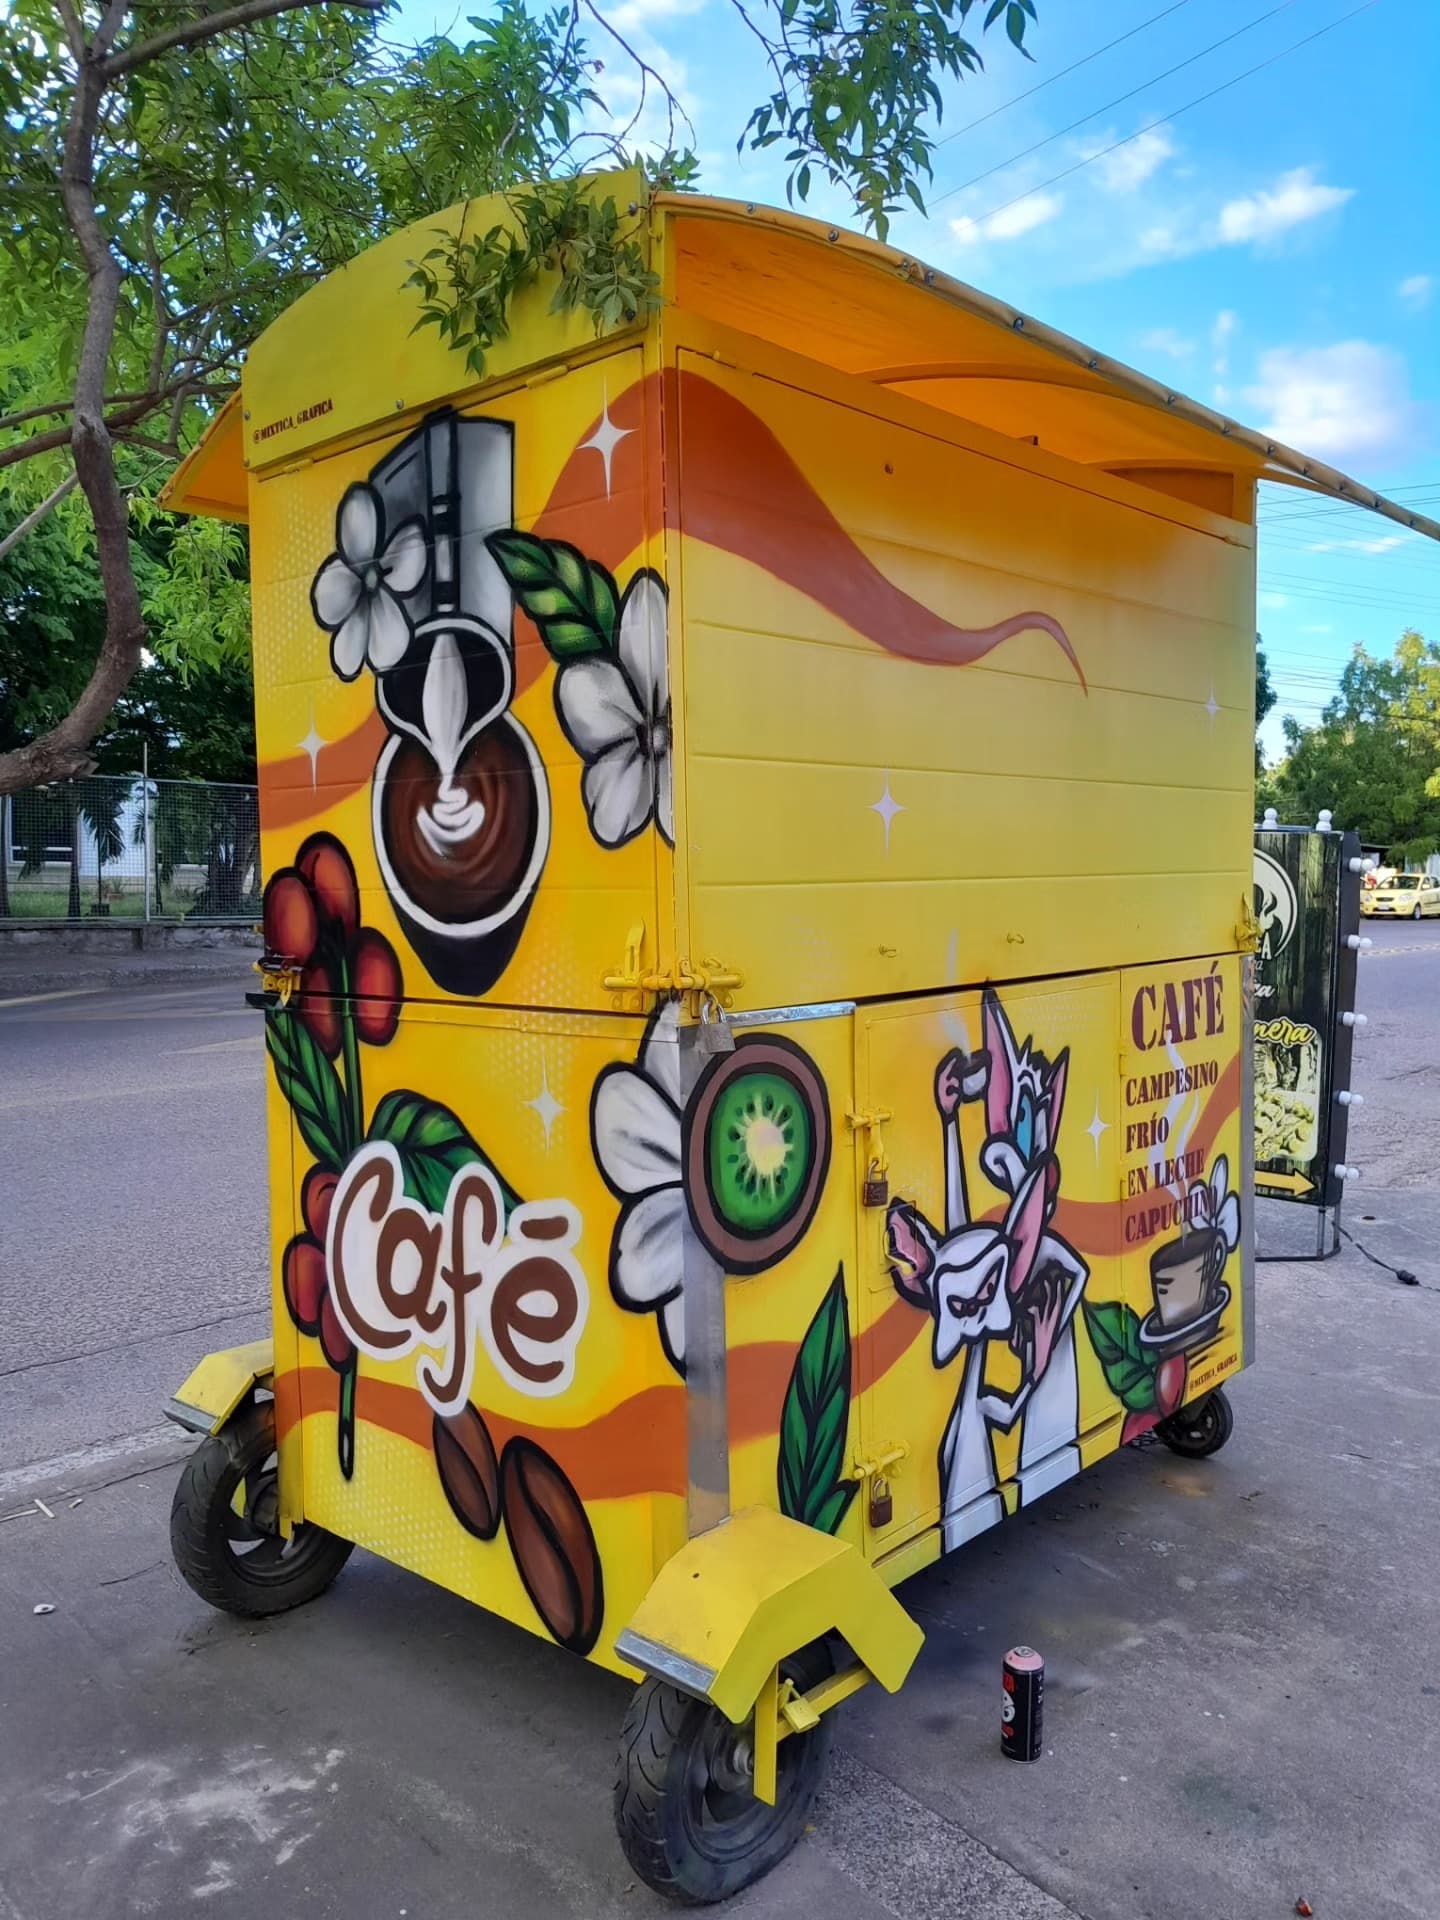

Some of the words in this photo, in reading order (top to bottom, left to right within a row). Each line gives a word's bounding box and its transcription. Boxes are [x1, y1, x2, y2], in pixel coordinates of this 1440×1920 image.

[1131, 961, 1224, 1050] CAFÉ
[1126, 1060, 1218, 1106] CAMPESINO
[1126, 1112, 1169, 1153] FRÍO
[1128, 1166, 1148, 1197] EN
[1154, 1148, 1204, 1189] LECHE
[1125, 1185, 1217, 1243] CAPUCHINO
[330, 1150, 582, 1407] Café
